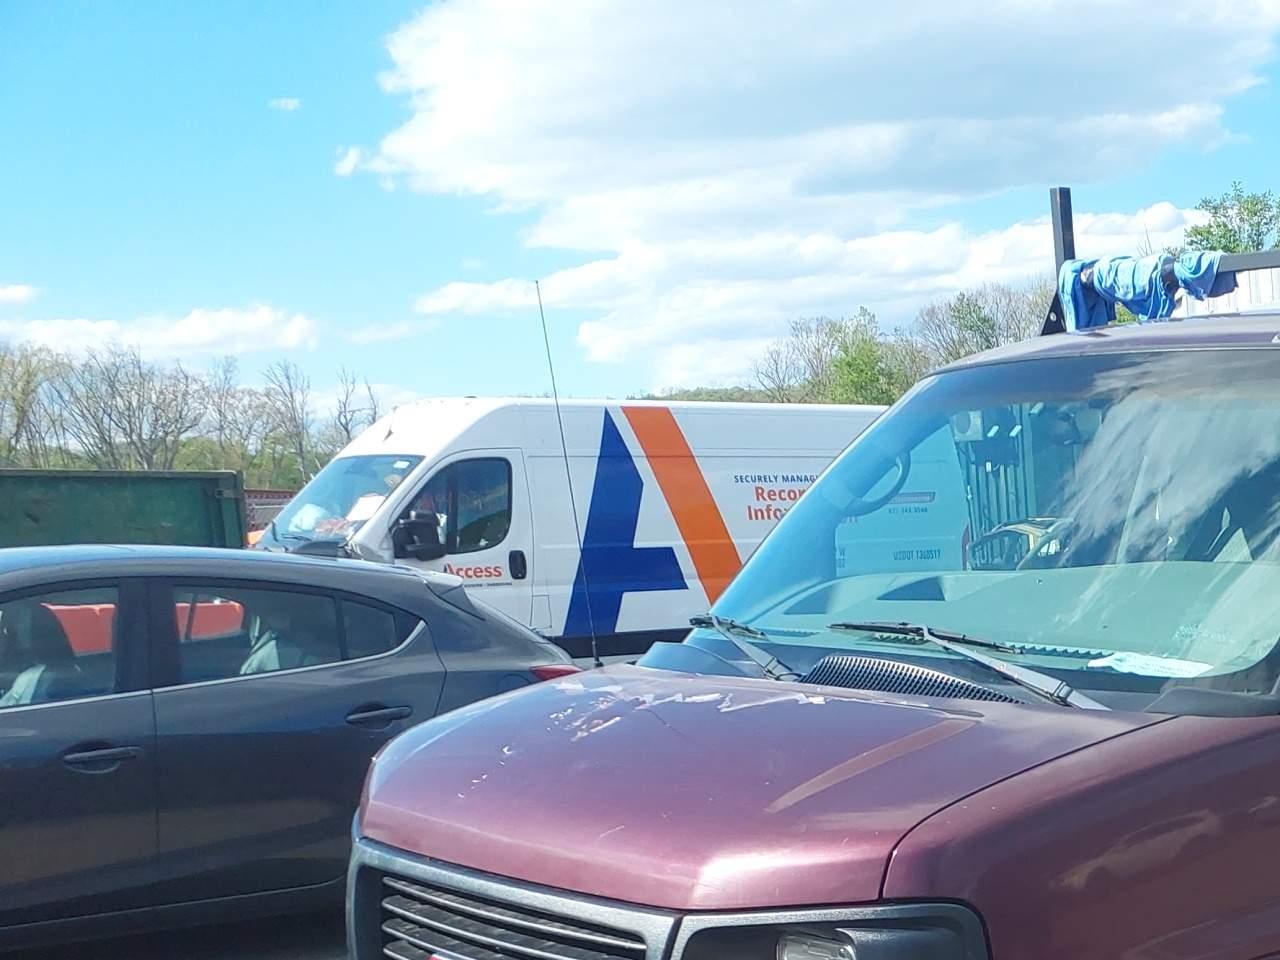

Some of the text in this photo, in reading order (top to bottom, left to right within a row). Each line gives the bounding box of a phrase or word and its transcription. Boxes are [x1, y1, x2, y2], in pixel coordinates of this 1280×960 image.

[734, 474, 819, 484] SECURELY MANAG
[747, 503, 788, 520] Info
[443, 562, 502, 578] Access
